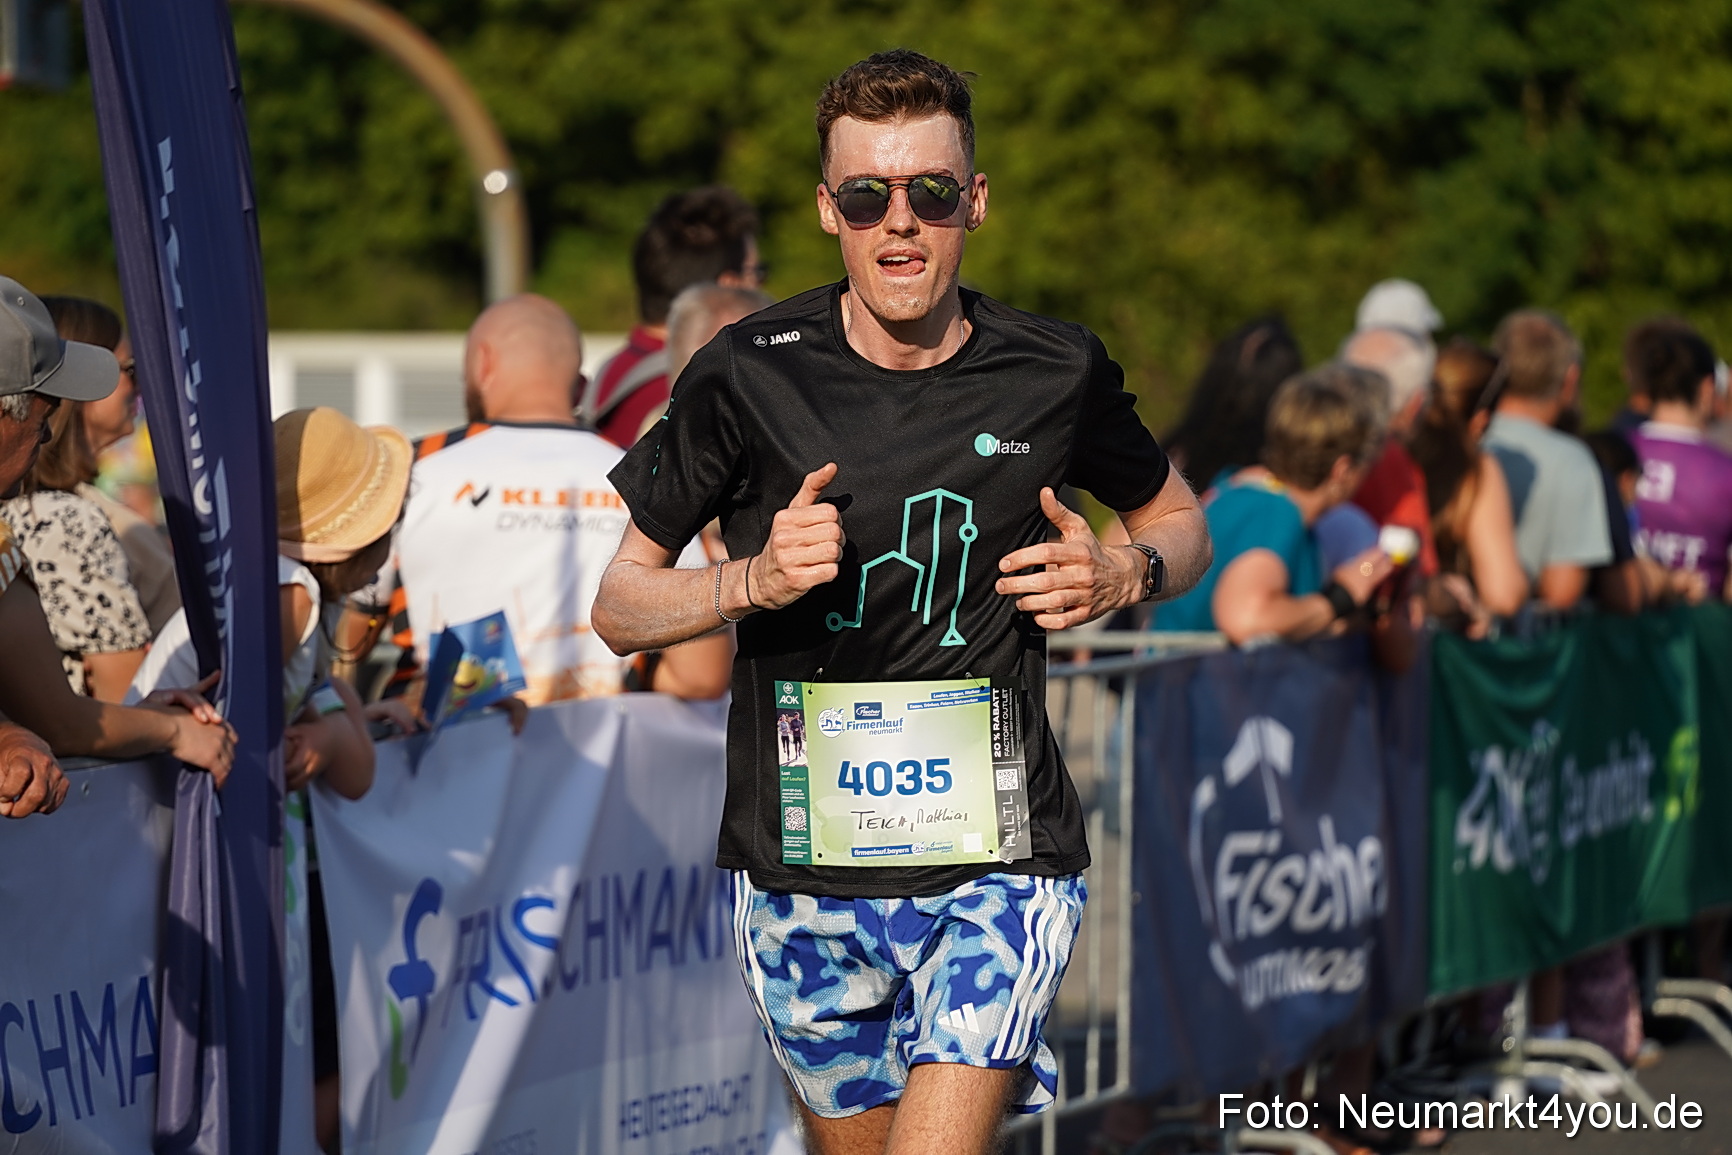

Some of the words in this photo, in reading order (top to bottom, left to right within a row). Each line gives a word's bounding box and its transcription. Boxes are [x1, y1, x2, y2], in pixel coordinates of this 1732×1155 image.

[769, 330, 800, 345] JAKO
[986, 439, 1030, 454] Matze
[779, 695, 800, 705] AOK
[992, 688, 1001, 731] RABATT
[847, 717, 904, 731] Firmenlauf
[869, 727, 903, 735] neumarkt
[993, 732, 1001, 741] %
[1002, 720, 1011, 757] FACTORY
[993, 742, 1002, 758] 20
[838, 758, 953, 797] 4035
[1002, 795, 1016, 847] HILTL
[853, 847, 910, 856] firmenlauf.bayern
